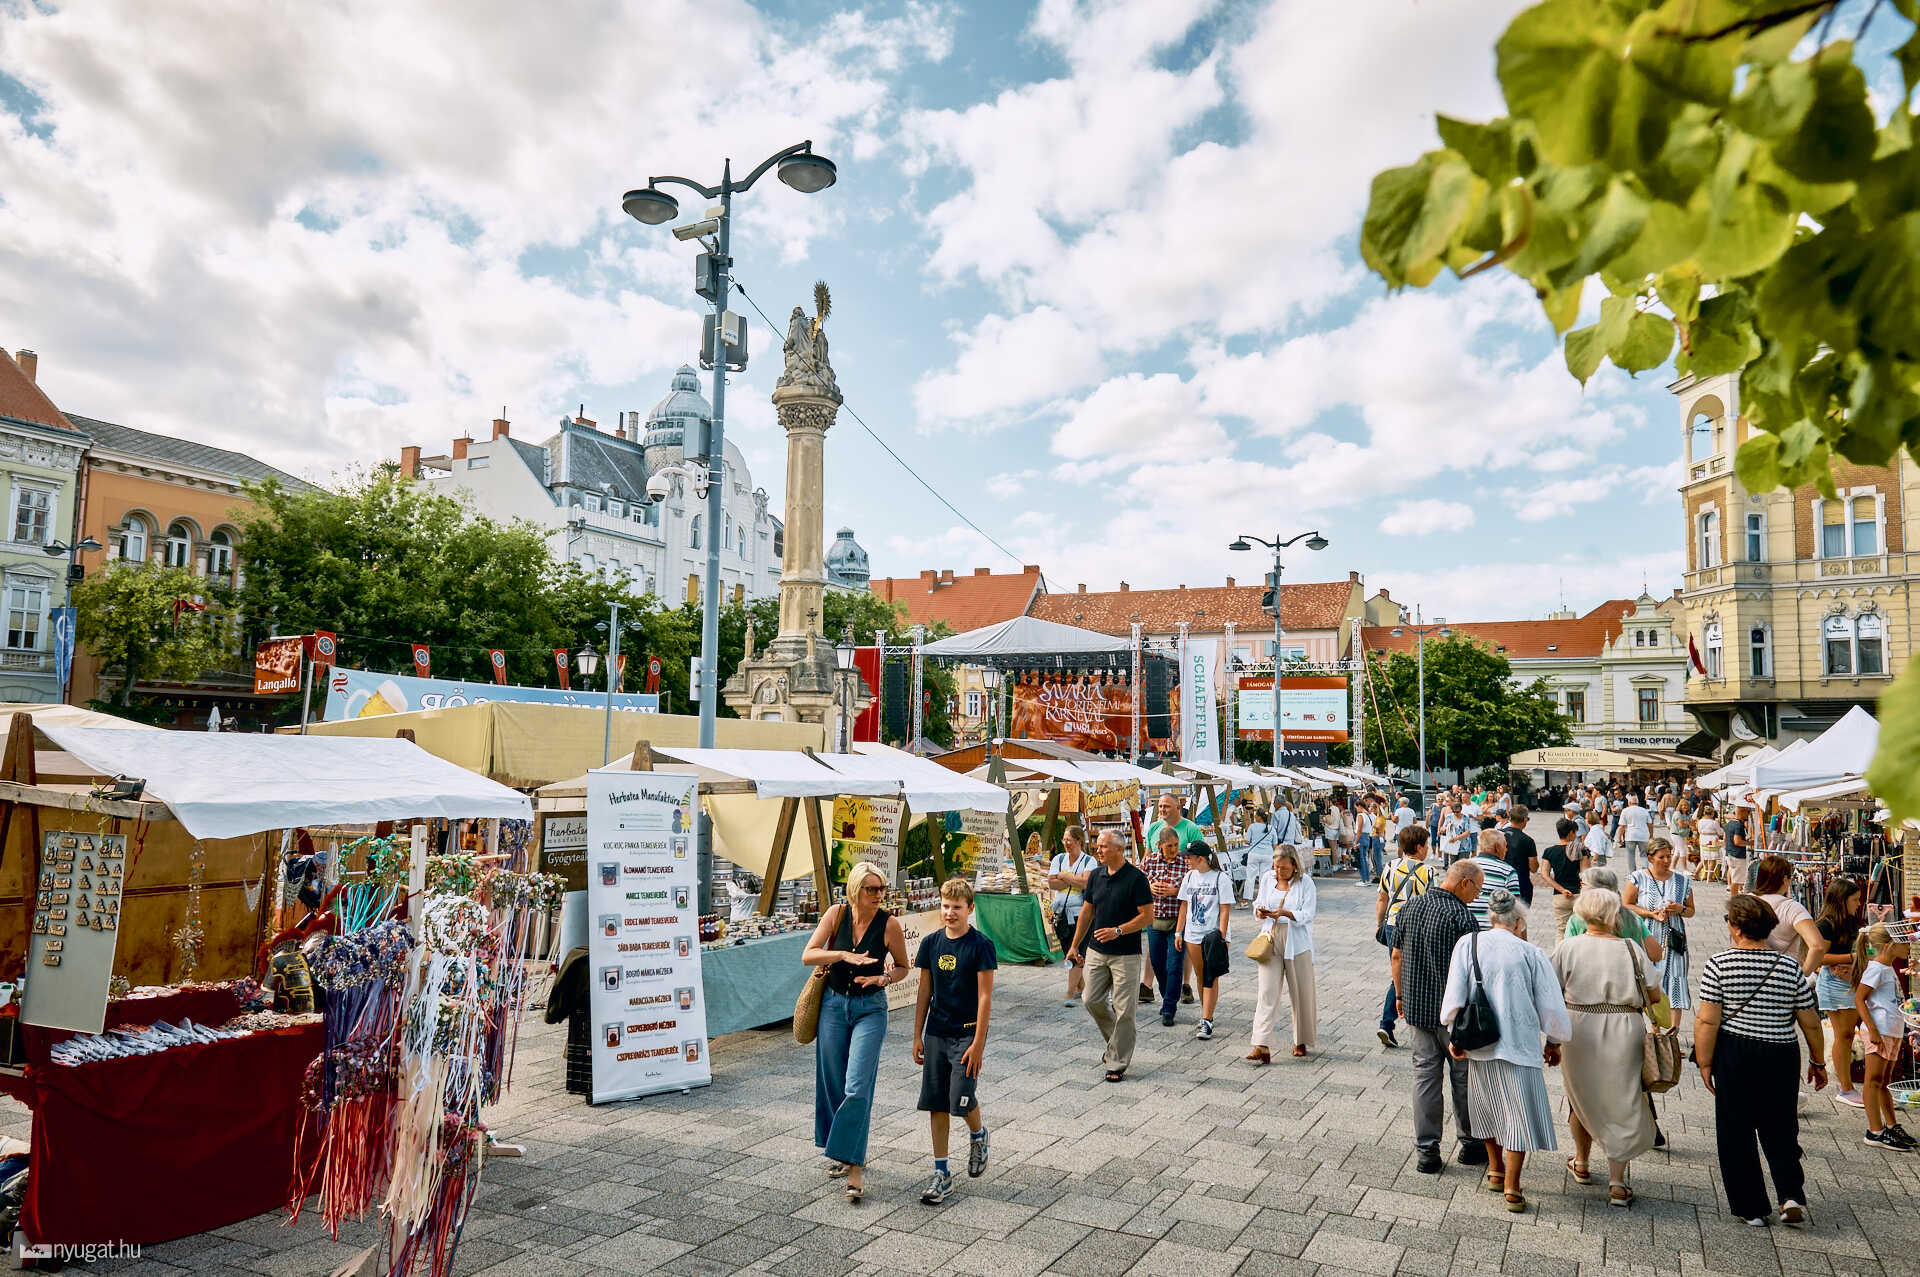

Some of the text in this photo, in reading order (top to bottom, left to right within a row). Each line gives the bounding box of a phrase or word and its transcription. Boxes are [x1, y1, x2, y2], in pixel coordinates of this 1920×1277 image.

[257, 677, 297, 692] Langalló
[1193, 655, 1207, 749] SCHAEFFLER
[1283, 749, 1320, 757] APTIV
[608, 788, 681, 806] Herbatea Manufaktúra
[647, 865, 674, 874] TEAKEVERÉK
[651, 915, 679, 925] TEAKEVERÉK
